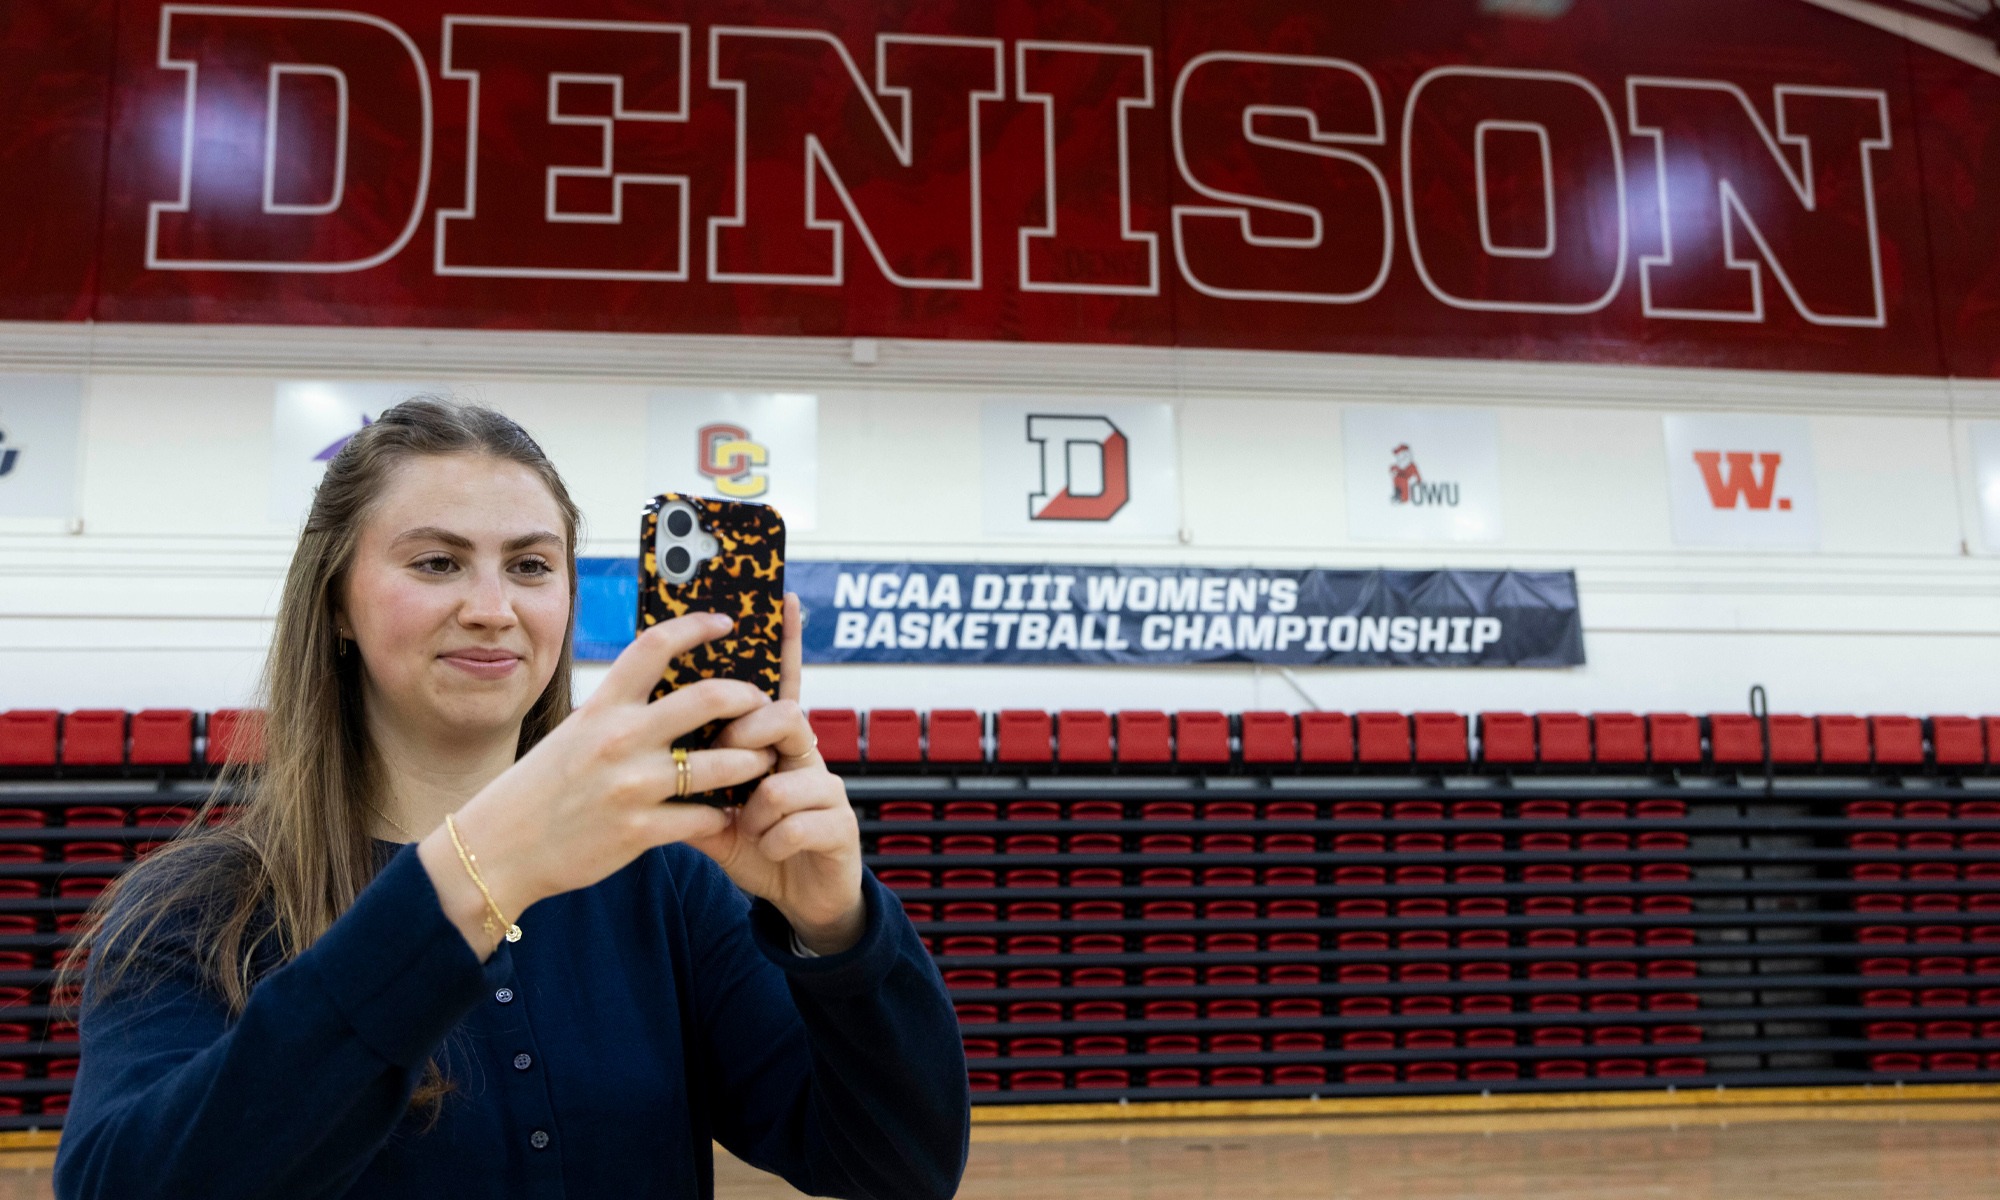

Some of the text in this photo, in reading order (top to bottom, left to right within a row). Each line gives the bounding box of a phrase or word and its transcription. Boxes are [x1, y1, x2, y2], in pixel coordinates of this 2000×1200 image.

[145, 4, 1892, 329] DENISON
[1027, 413, 1130, 521] D
[1692, 451, 1793, 510] W.
[1410, 481, 1460, 507] OWU
[833, 572, 1299, 612] NCAA DIII WOMEN'S
[832, 612, 1502, 654] BASKETBALL CHAMPIONSHIP
